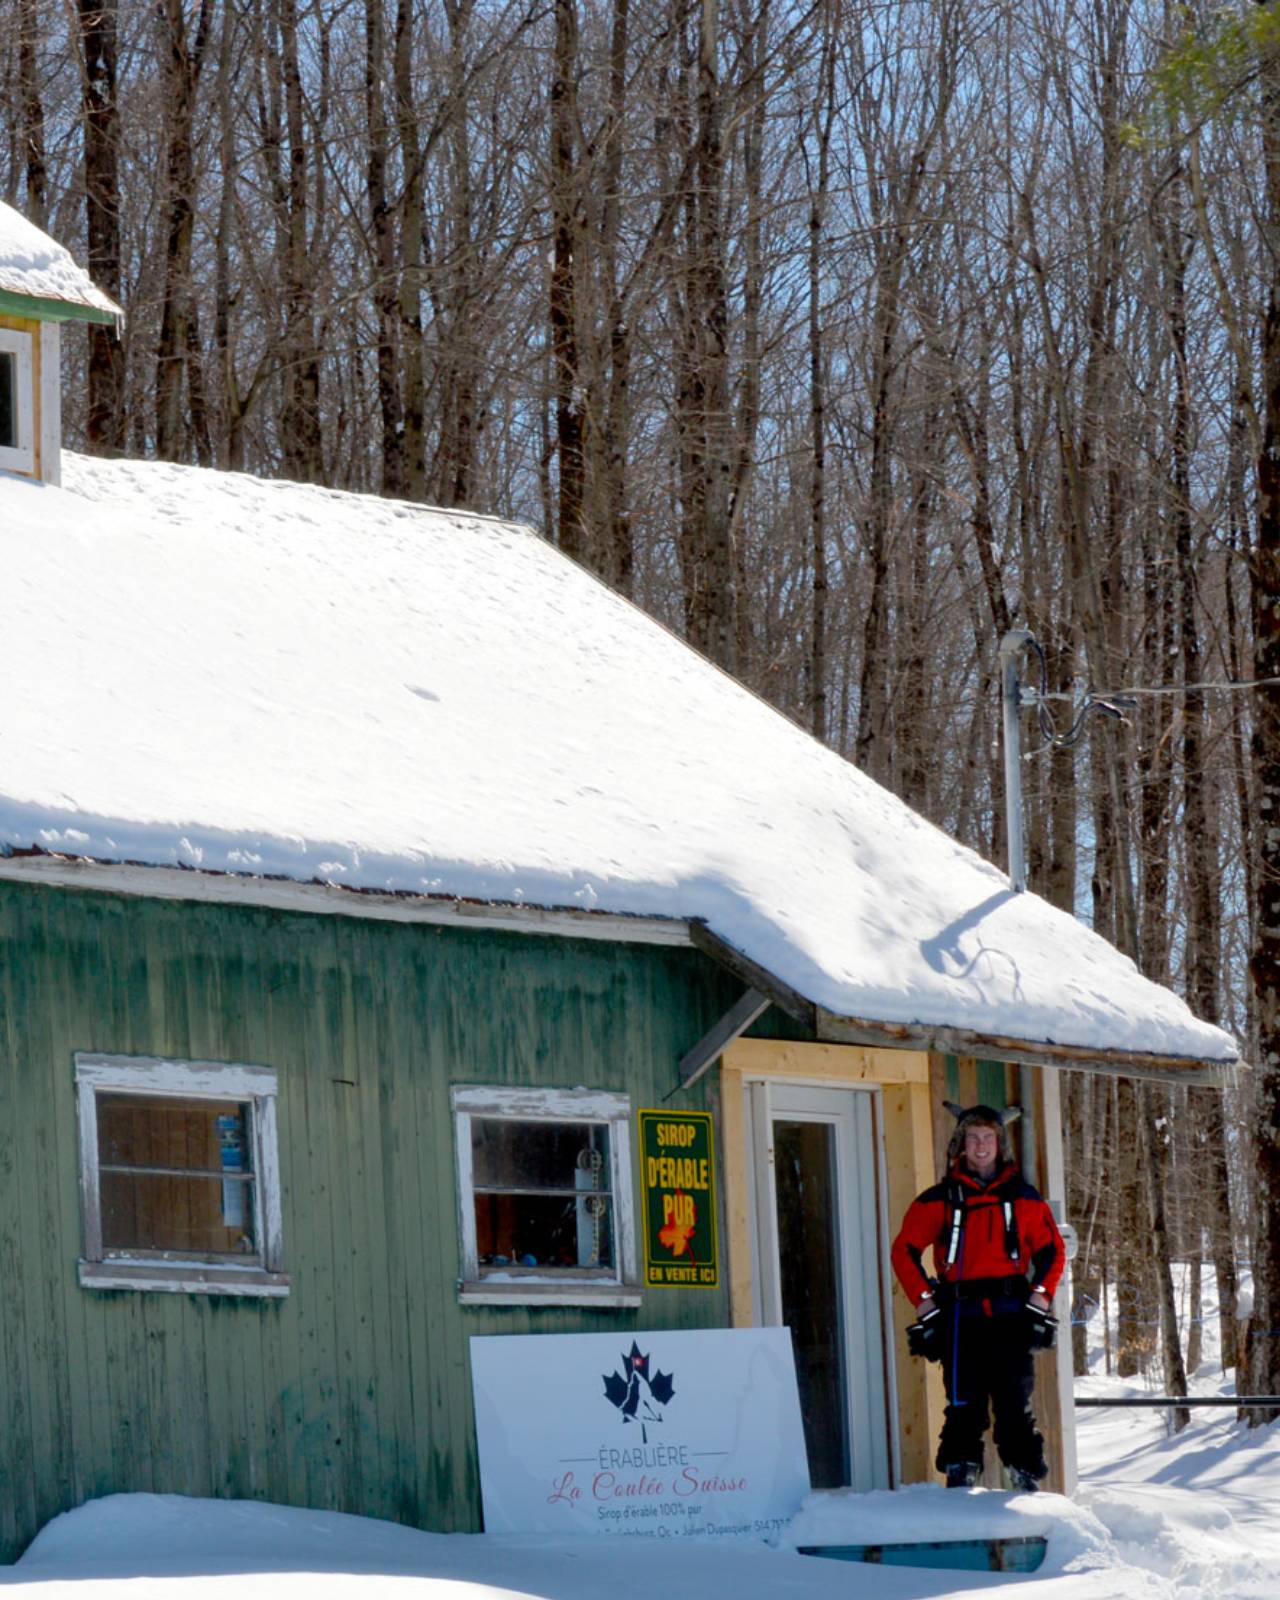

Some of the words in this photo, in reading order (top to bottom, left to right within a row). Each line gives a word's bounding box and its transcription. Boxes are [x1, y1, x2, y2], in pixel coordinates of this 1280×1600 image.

[656, 1123, 696, 1148] SIROP
[647, 1149, 709, 1190] D'ÉRABLE
[662, 1194, 696, 1226] PUR
[650, 1267, 663, 1281] EN
[666, 1267, 698, 1282] VENTE
[700, 1268, 715, 1282] ICI
[598, 1443, 689, 1470] ÉRABLIÈRE
[547, 1471, 582, 1507] La
[592, 1471, 664, 1502] Coulée
[672, 1467, 748, 1496] Suisse
[597, 1507, 622, 1523] Sirop
[623, 1503, 658, 1519] d'érable
[659, 1502, 686, 1517] 100%
[687, 1504, 702, 1518] pur
